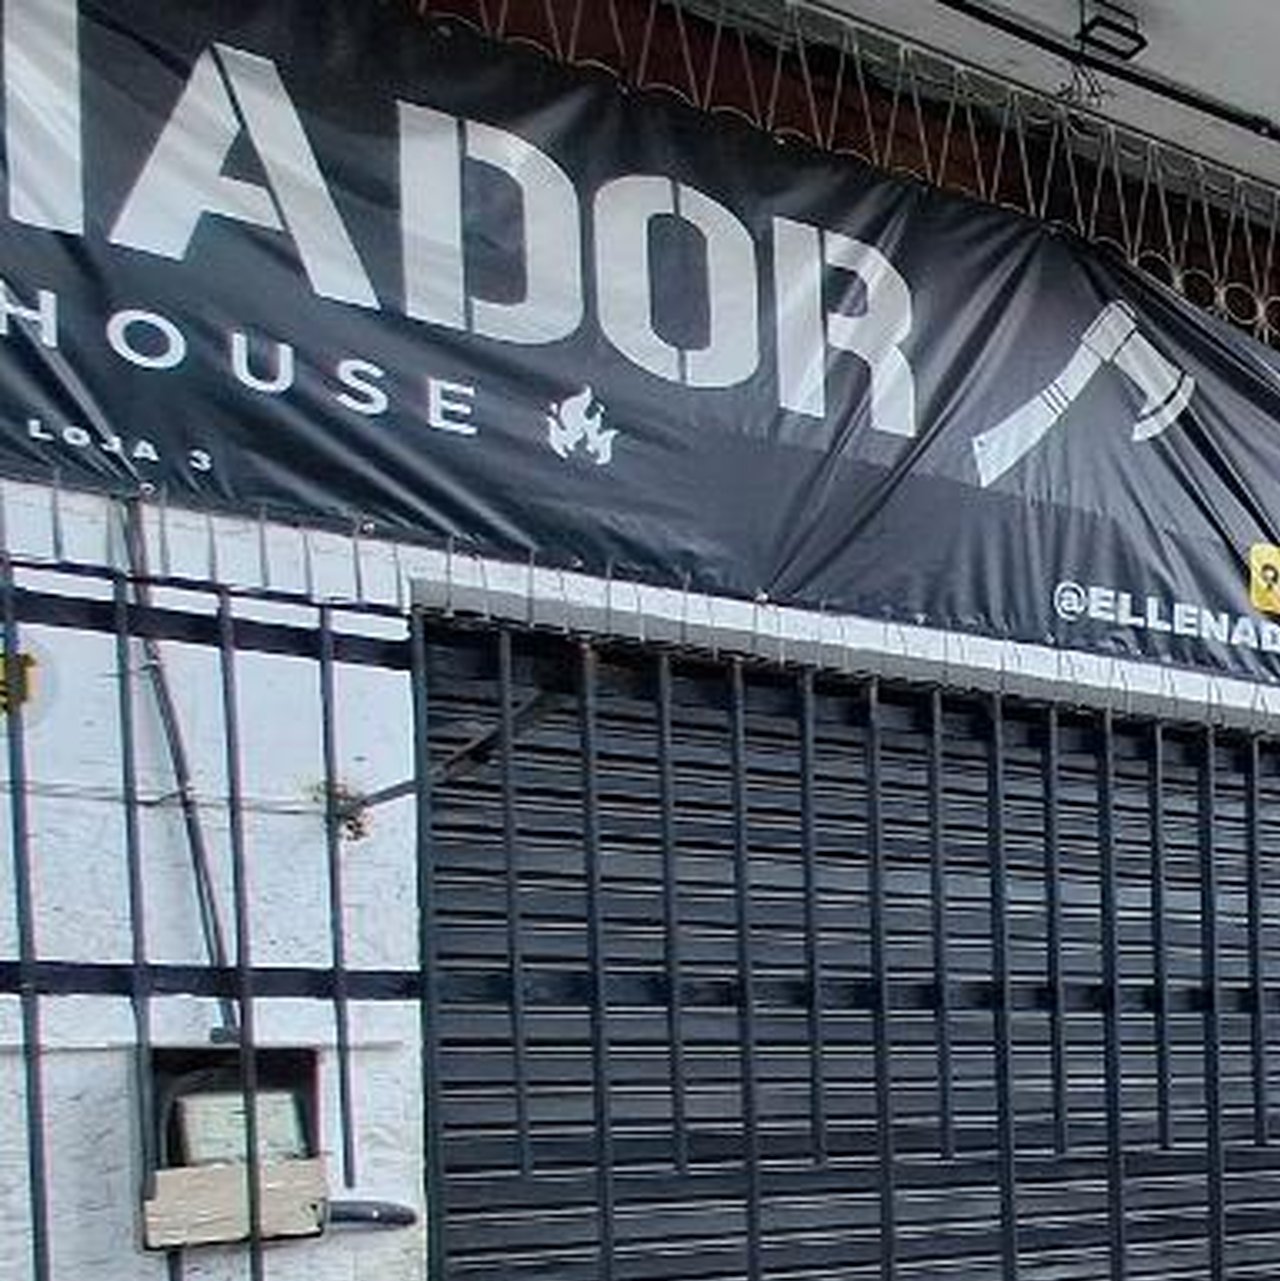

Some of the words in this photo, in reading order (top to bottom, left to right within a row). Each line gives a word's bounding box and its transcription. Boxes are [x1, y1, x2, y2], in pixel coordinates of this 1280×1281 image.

[0, 281, 478, 436] HOUSE
[28, 418, 160, 463] LOJA
[189, 450, 213, 472] 3
